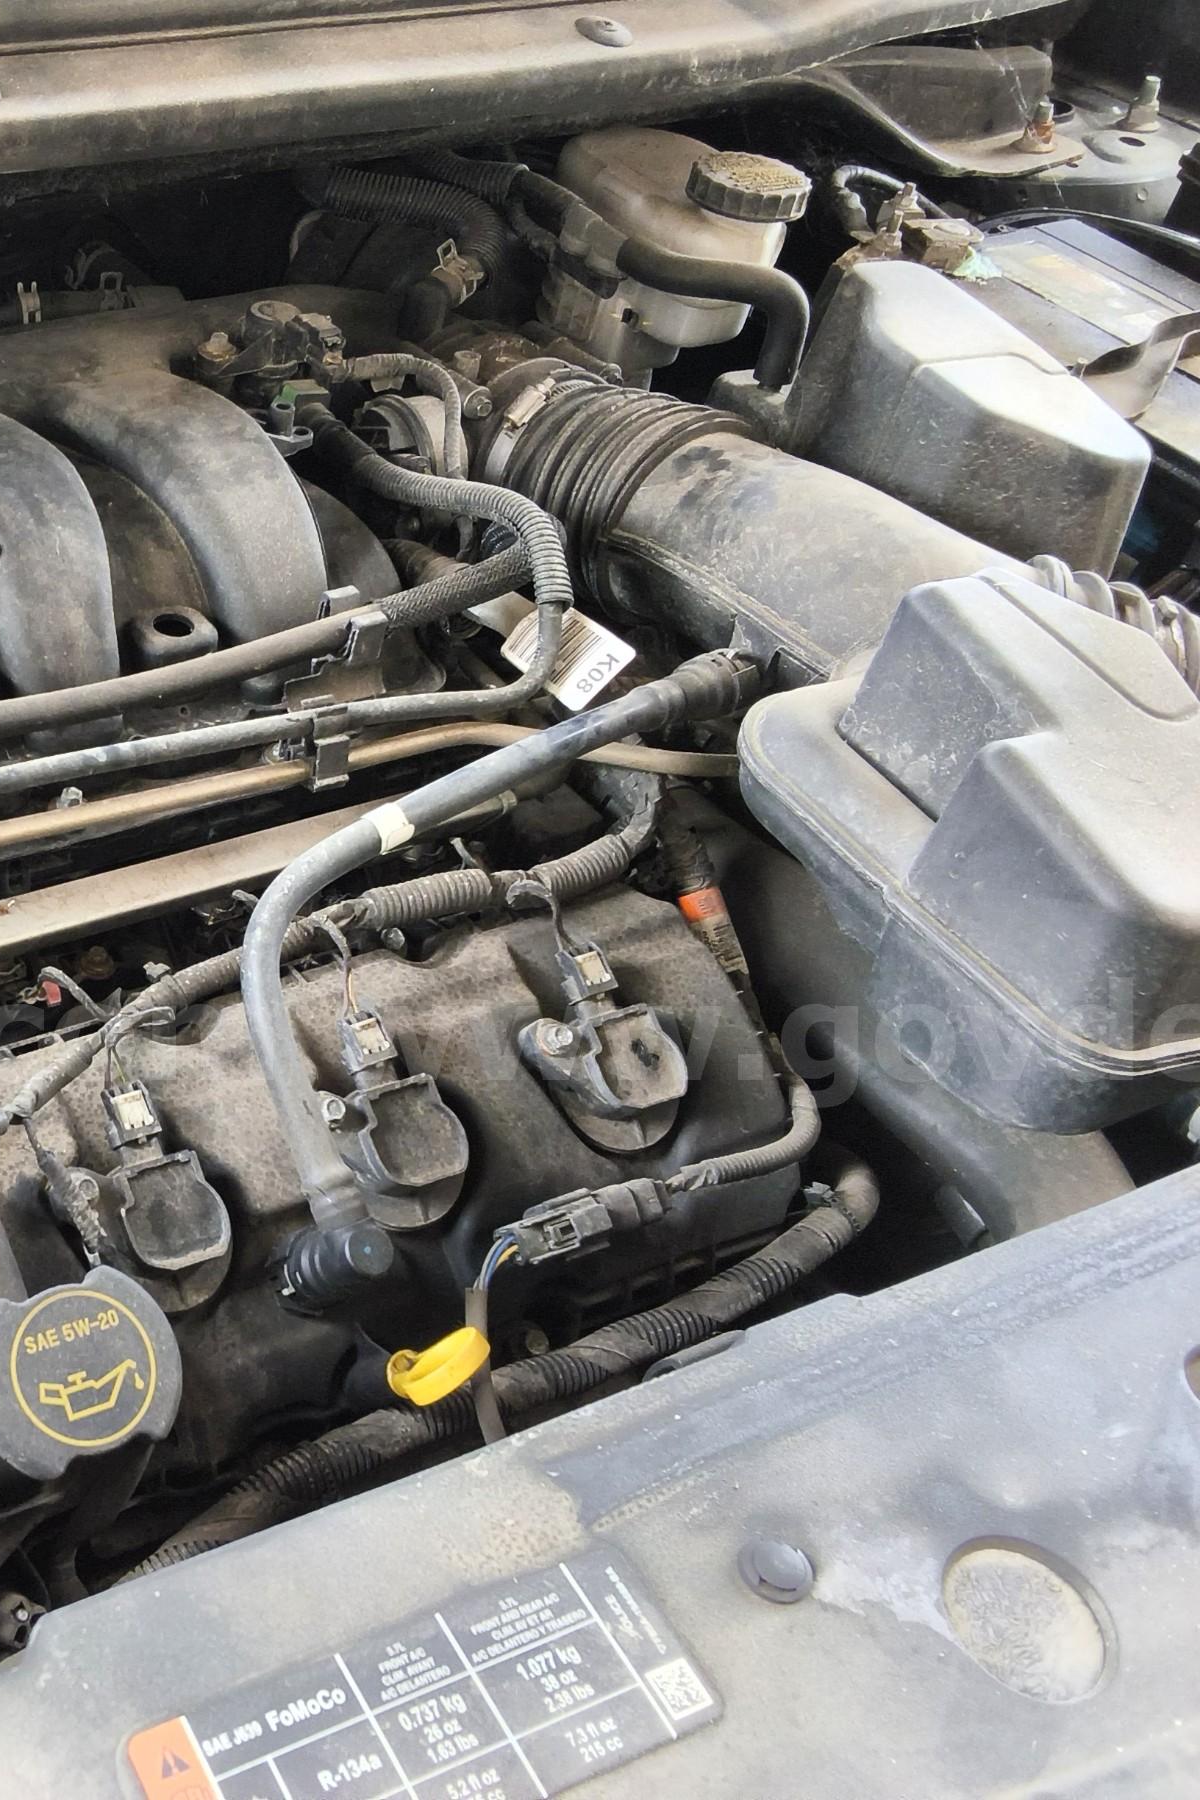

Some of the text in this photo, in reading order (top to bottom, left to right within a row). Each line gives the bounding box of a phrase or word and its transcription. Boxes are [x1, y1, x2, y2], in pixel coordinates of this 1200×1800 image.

[576, 653, 621, 693] K08
[24, 1309, 120, 1354] SAE 5W-20
[516, 1645, 582, 1680] 1.077 kg
[540, 1669, 578, 1693] 38 oz
[398, 1693, 467, 1732] 0.737 kg
[544, 1683, 595, 1713] 2.38 lbs
[201, 1732, 233, 1757] SAE
[264, 1687, 346, 1732] FoMoCo
[423, 1717, 463, 1744] 26 oz
[564, 1717, 618, 1748] 7.3 fl oz
[426, 1733, 479, 1764] 1.63 lbs
[579, 1736, 624, 1762] 215 cc
[316, 1753, 382, 1791] R-134a
[446, 1768, 501, 1799] 5.2 fl oz
